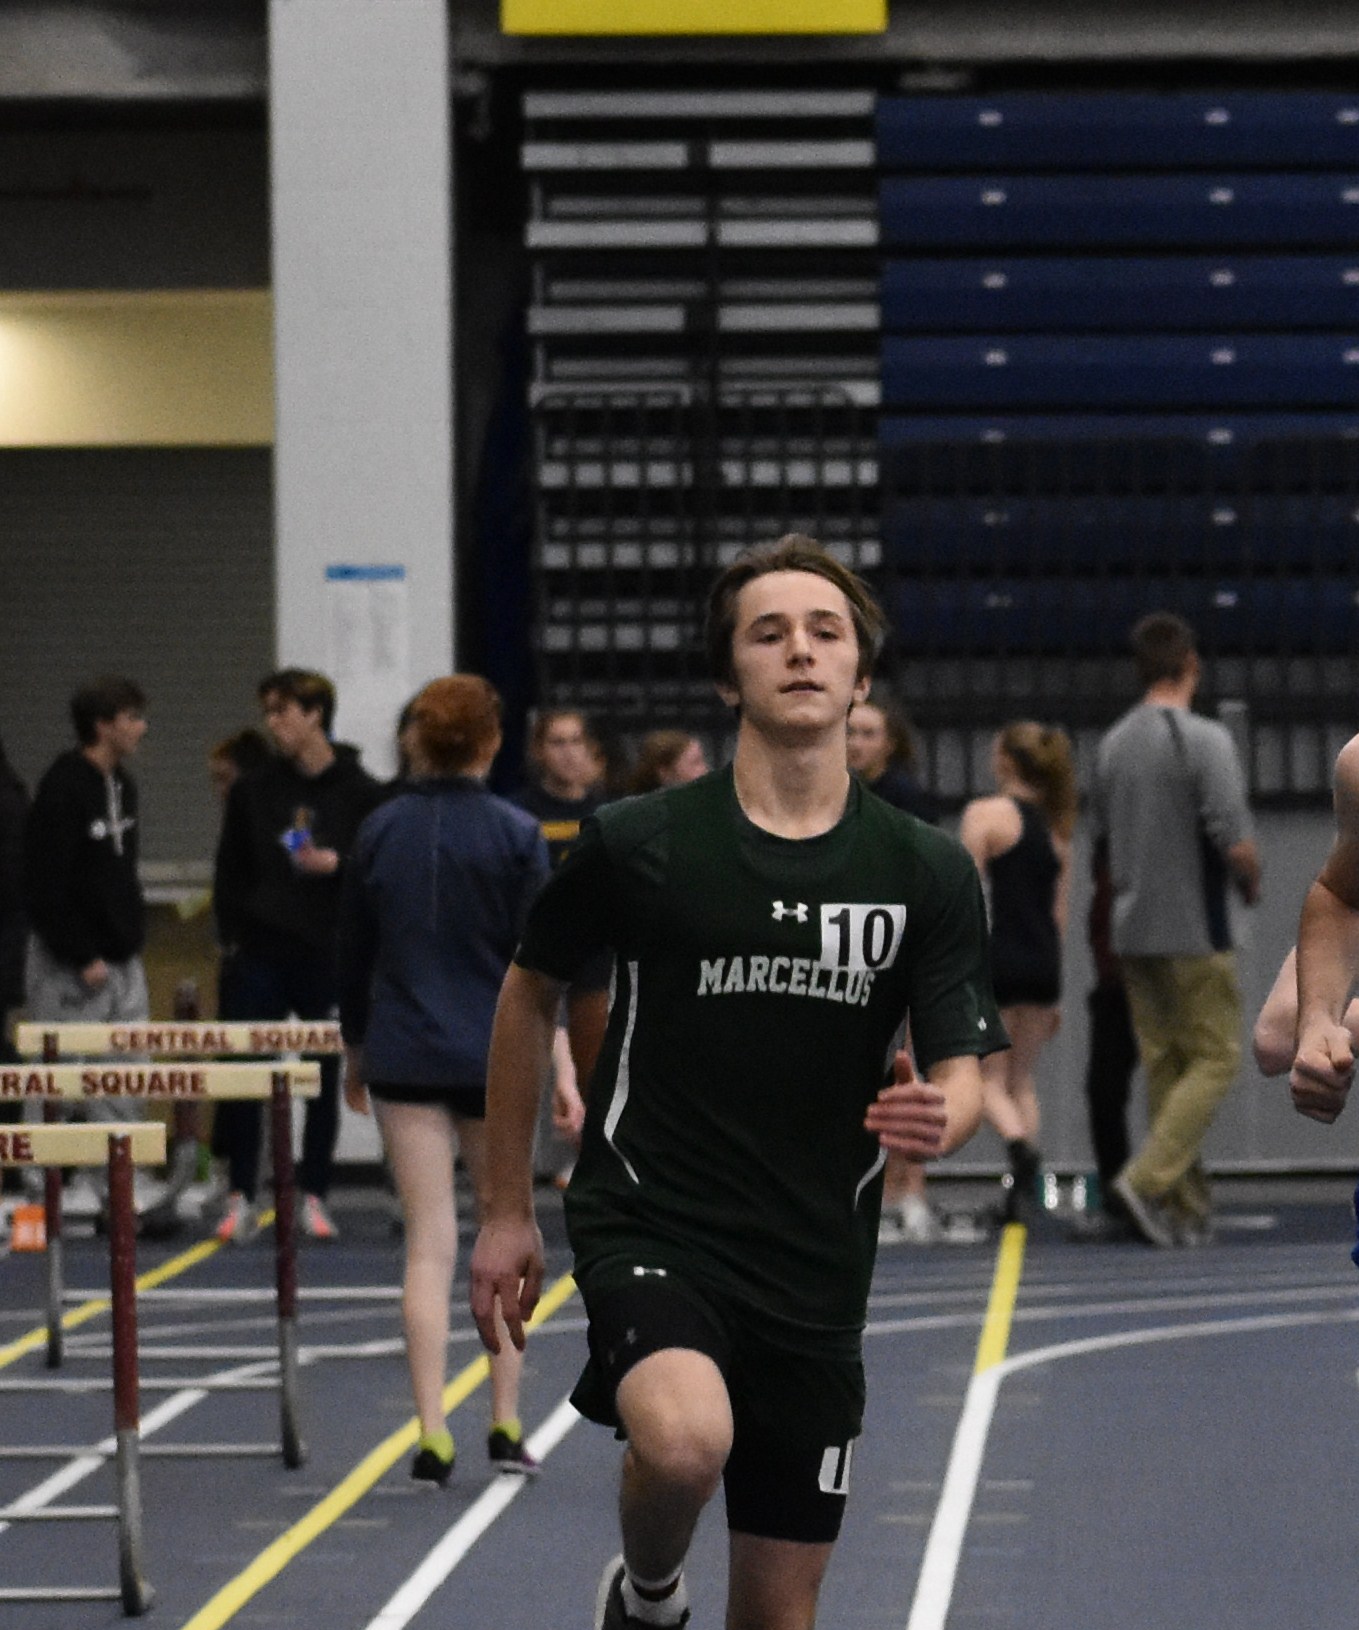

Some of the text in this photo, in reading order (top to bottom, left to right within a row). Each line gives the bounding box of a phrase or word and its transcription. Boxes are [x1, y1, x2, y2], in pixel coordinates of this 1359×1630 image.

[828, 907, 895, 968] 10
[697, 955, 875, 1007] MARCELLUS
[110, 1029, 233, 1052] CENTRAL
[82, 1071, 207, 1096] SQUARE
